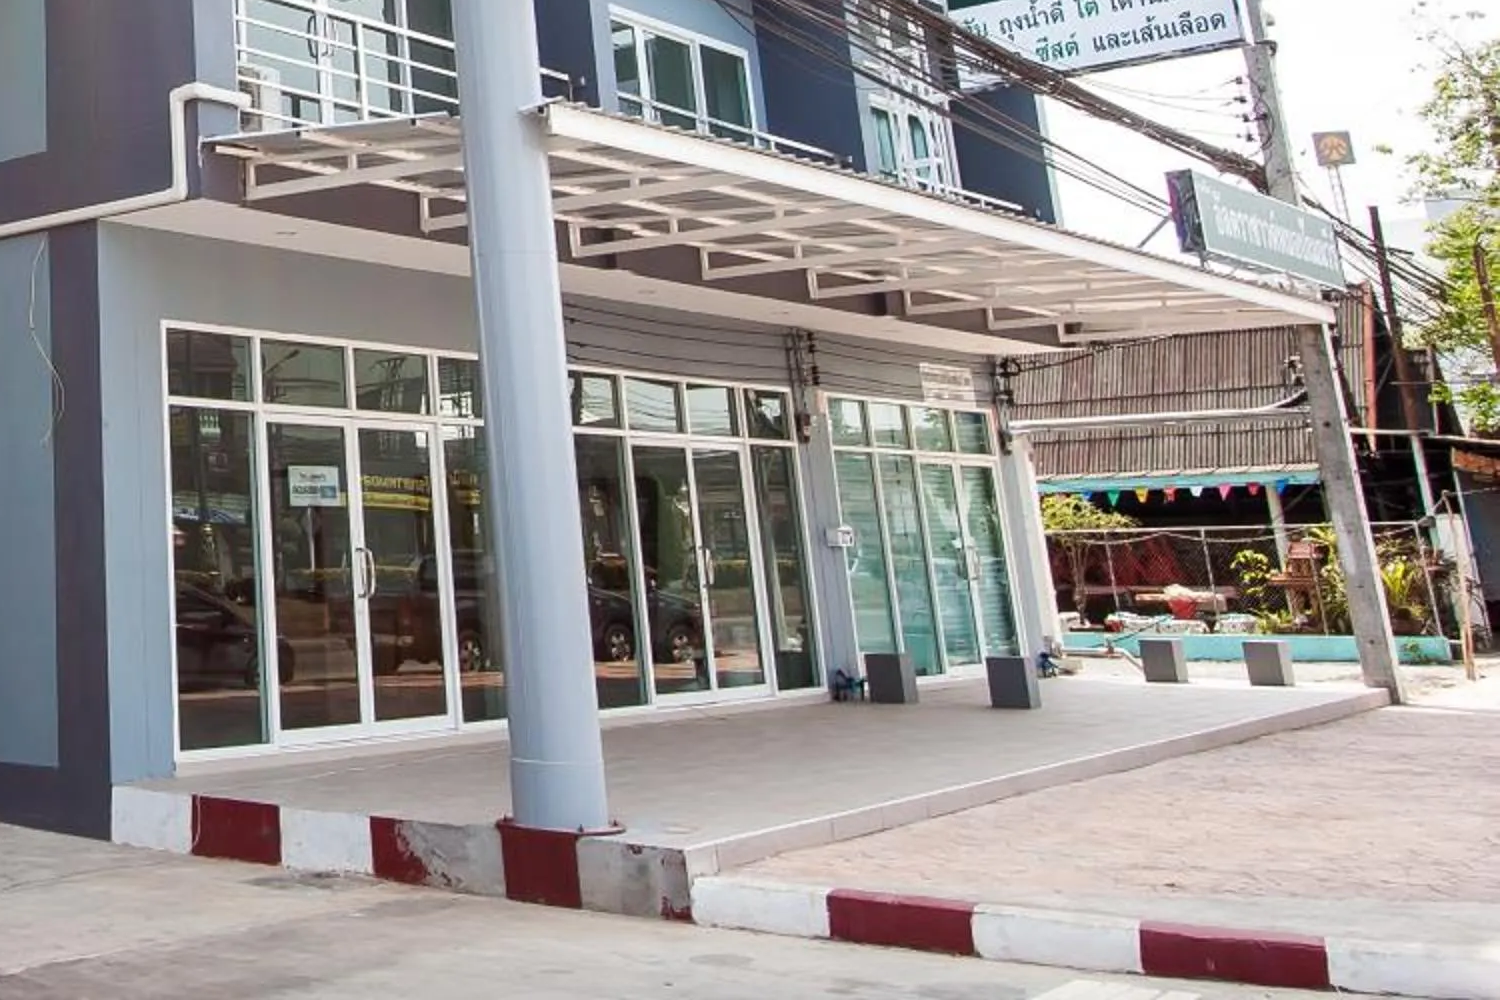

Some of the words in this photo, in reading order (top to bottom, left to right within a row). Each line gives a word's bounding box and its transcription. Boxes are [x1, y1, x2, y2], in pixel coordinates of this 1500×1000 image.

[1035, 31, 1080, 63] ซีสต์
[1092, 9, 1227, 53] และเส้นเลือด
